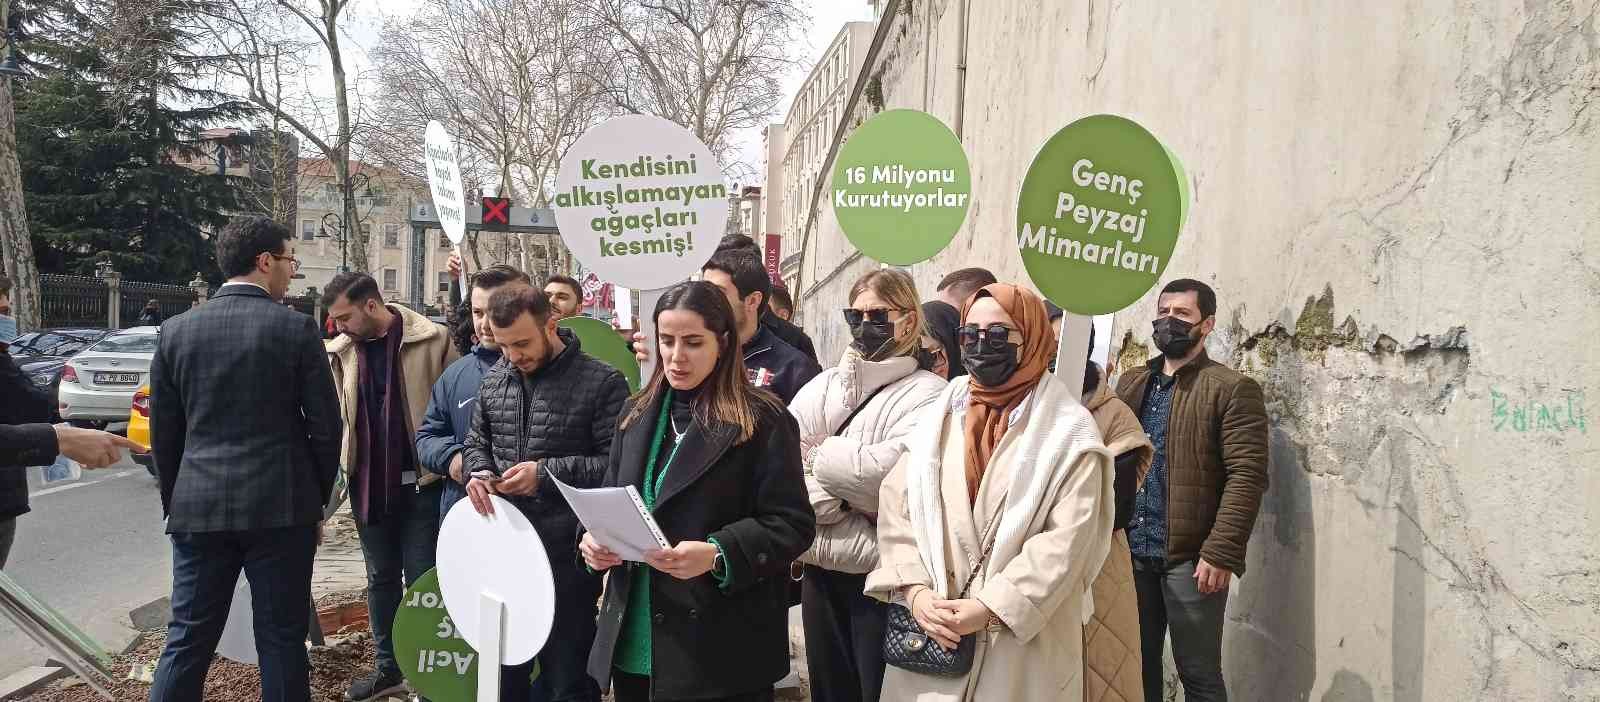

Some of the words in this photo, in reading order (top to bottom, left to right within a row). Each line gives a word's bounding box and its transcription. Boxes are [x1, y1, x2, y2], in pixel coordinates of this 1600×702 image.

[582, 153, 697, 179] Kendisini
[846, 167, 866, 184] 16
[872, 164, 955, 189] Milyonu
[1072, 158, 1143, 205] Genç
[555, 182, 727, 210] alkışlamayan
[835, 188, 968, 213] Kurutuyorlar
[590, 207, 697, 237] ağaçları
[1055, 191, 1148, 243] Peyzaj
[600, 231, 694, 257] kesmiş!
[1018, 222, 1159, 274] Mimarları
[417, 649, 475, 675] Acil
